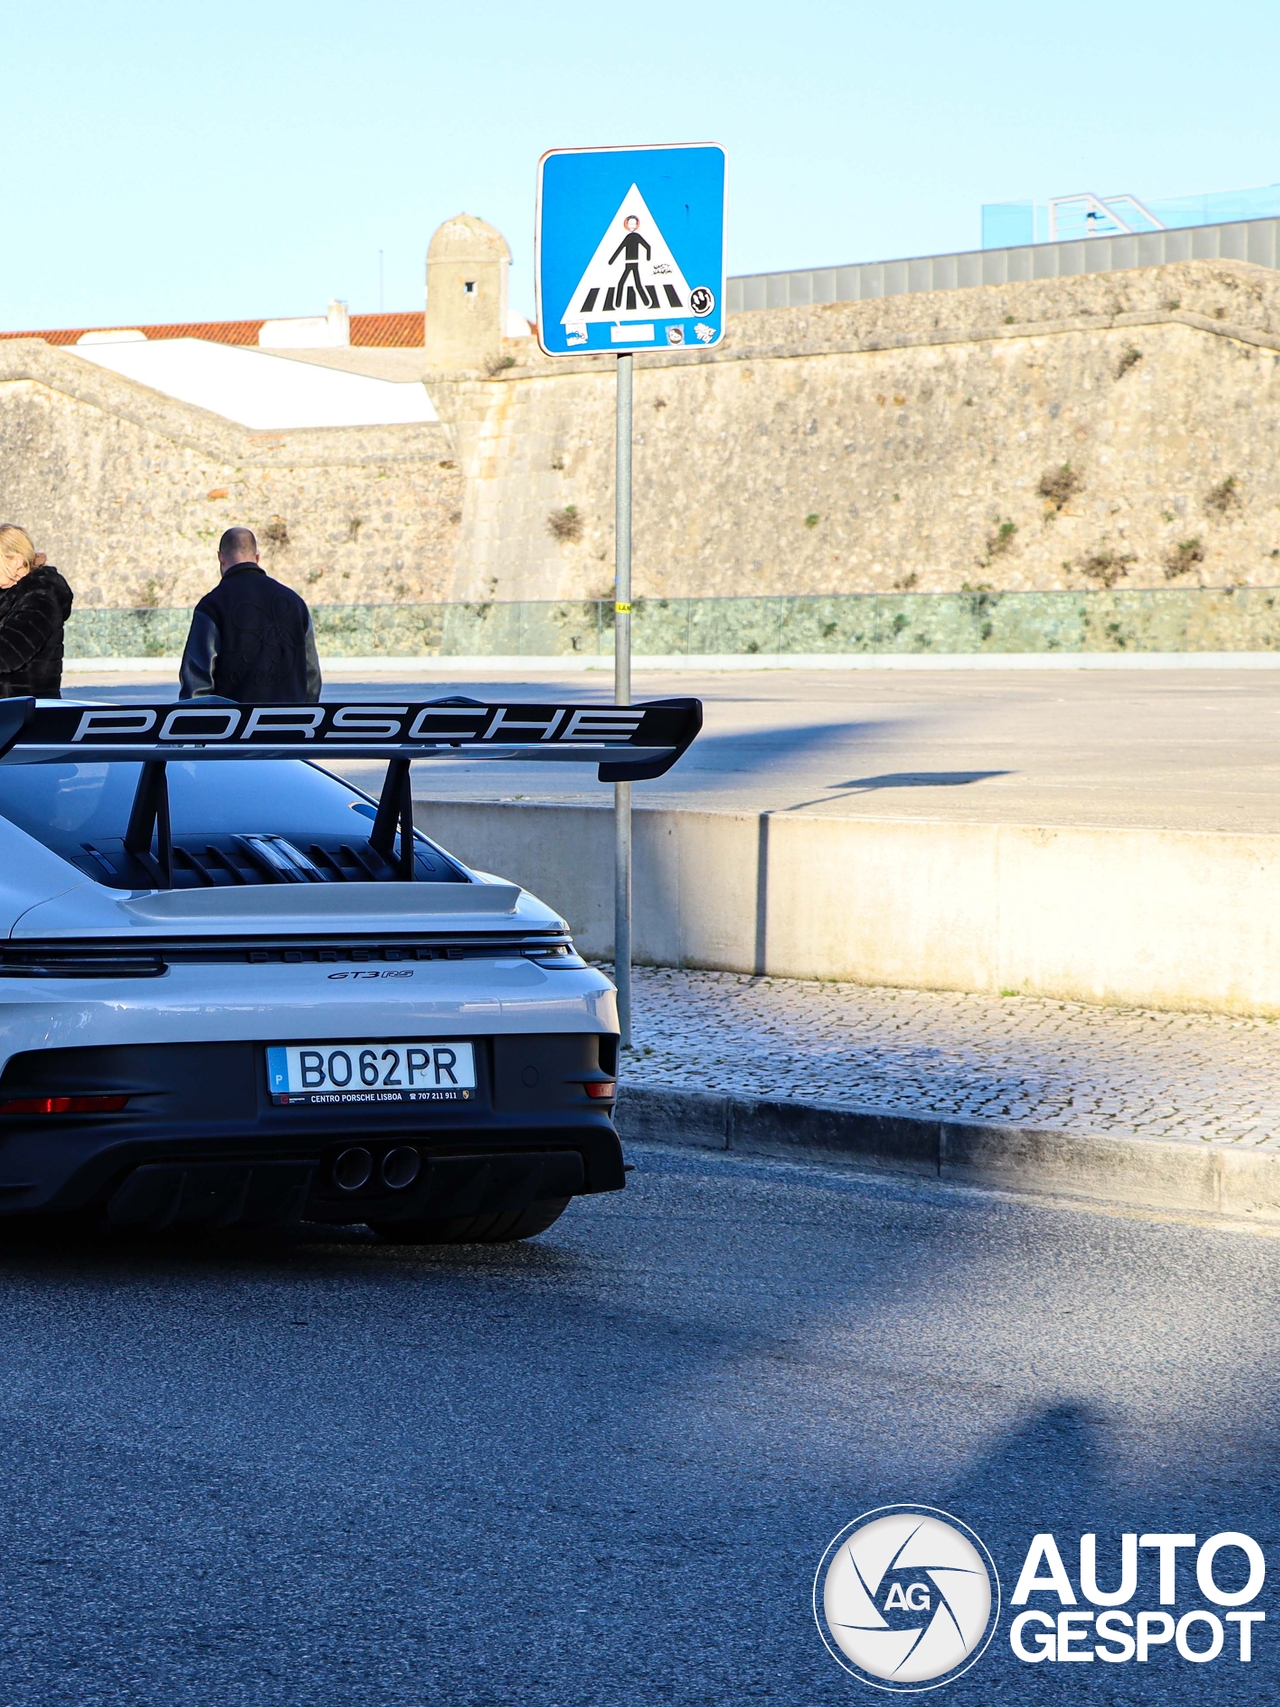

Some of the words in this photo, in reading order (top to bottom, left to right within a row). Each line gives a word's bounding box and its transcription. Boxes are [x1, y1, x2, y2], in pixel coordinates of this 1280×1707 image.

[71, 706, 648, 742] PORSCHE
[247, 948, 464, 963] PORSCHE
[275, 1074, 283, 1085] P
[310, 1094, 340, 1103] CENTRO
[341, 1093, 376, 1102] PORSCHE
[376, 1092, 403, 1101] LISBOA
[418, 1092, 431, 1100] 707
[431, 1092, 444, 1100] 211
[444, 1091, 457, 1100] 911
